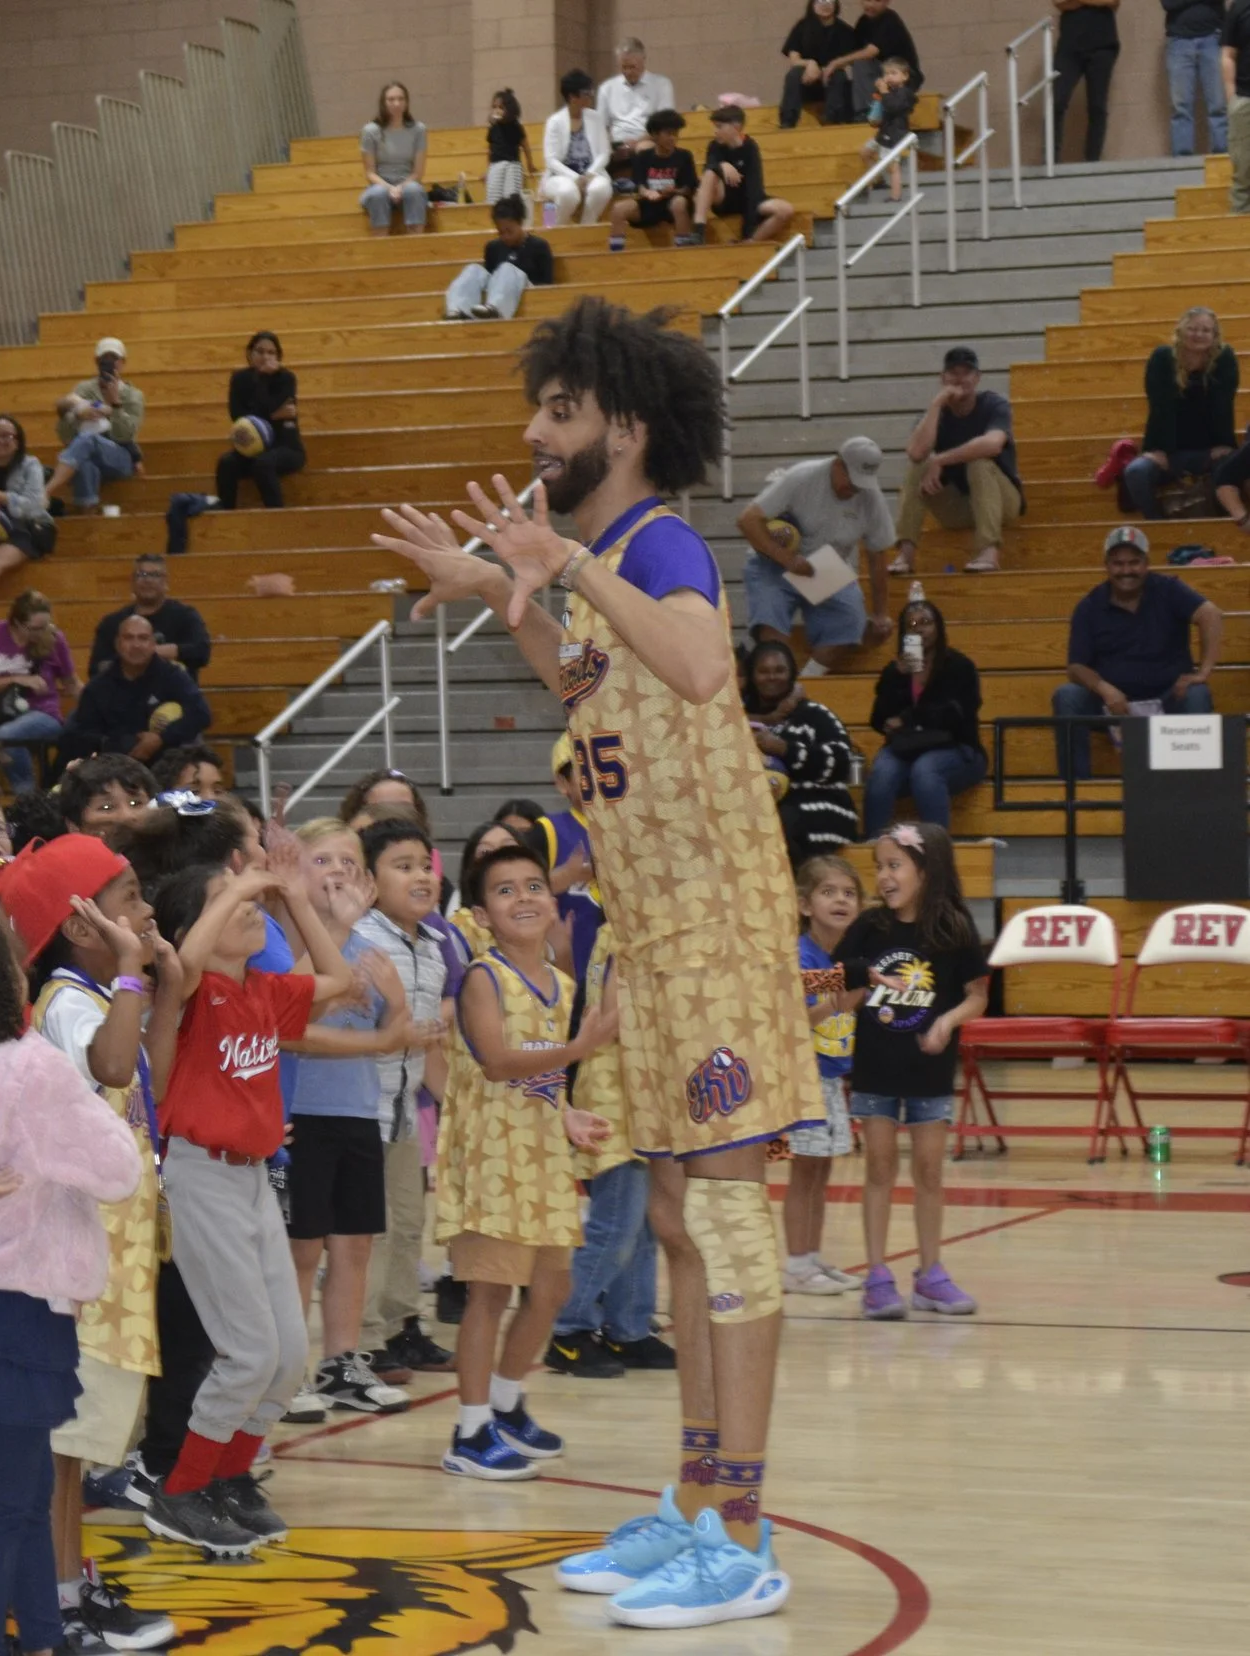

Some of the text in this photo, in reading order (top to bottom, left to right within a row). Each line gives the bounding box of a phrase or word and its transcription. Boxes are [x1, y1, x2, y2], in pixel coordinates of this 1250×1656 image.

[1160, 725, 1212, 736] Reserved
[1171, 742, 1201, 752] Seats
[1022, 915, 1097, 947] REV
[1171, 913, 1246, 946] REV
